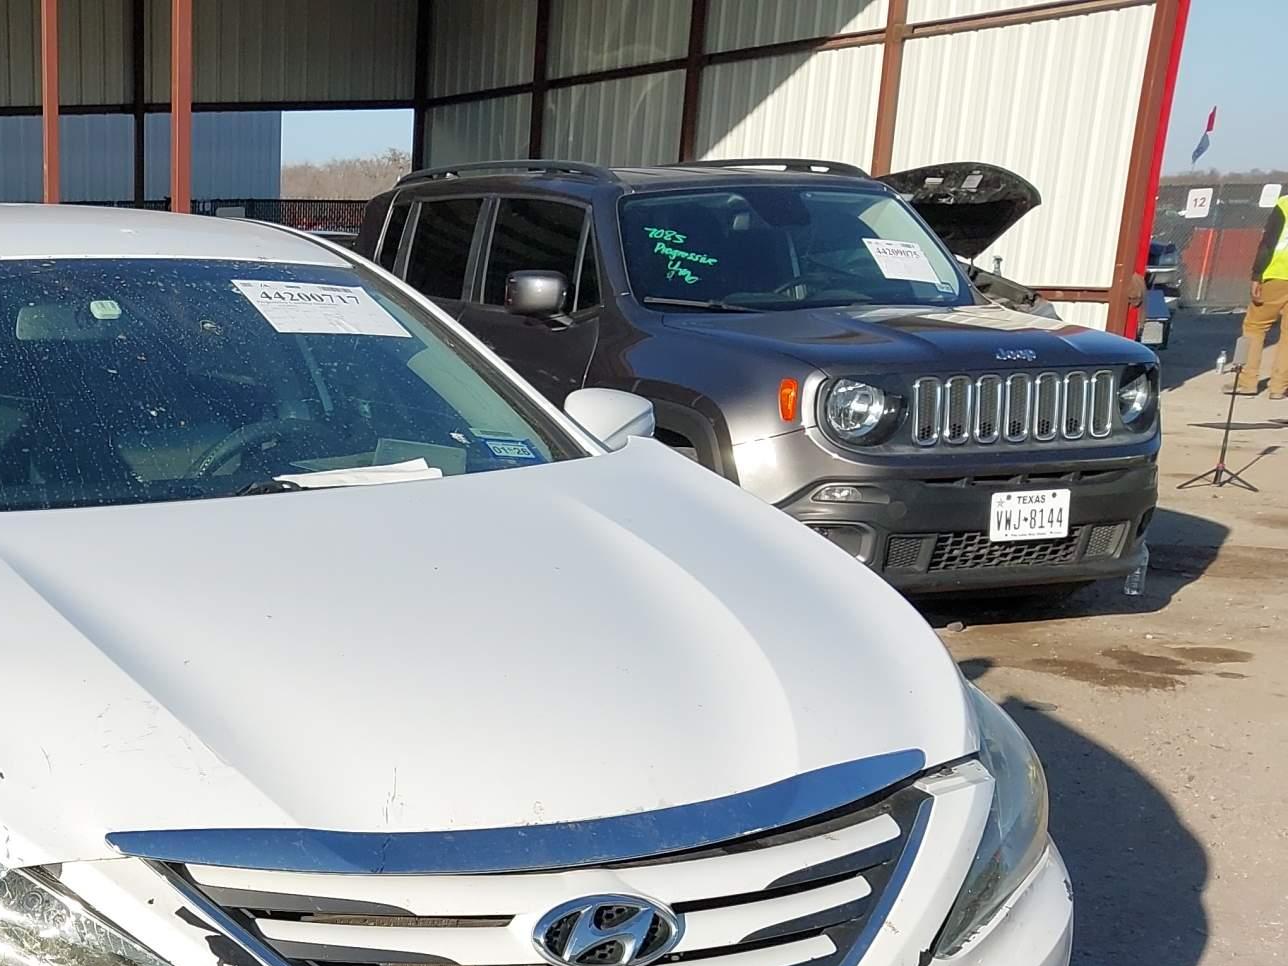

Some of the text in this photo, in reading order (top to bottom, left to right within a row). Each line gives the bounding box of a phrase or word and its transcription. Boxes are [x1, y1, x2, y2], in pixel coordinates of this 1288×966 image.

[1193, 197, 1206, 209] 12
[260, 290, 361, 305] 44200717
[996, 348, 1037, 362] Jeep
[1016, 495, 1046, 505] TEXAS
[996, 507, 1063, 532] VWJ 8144
